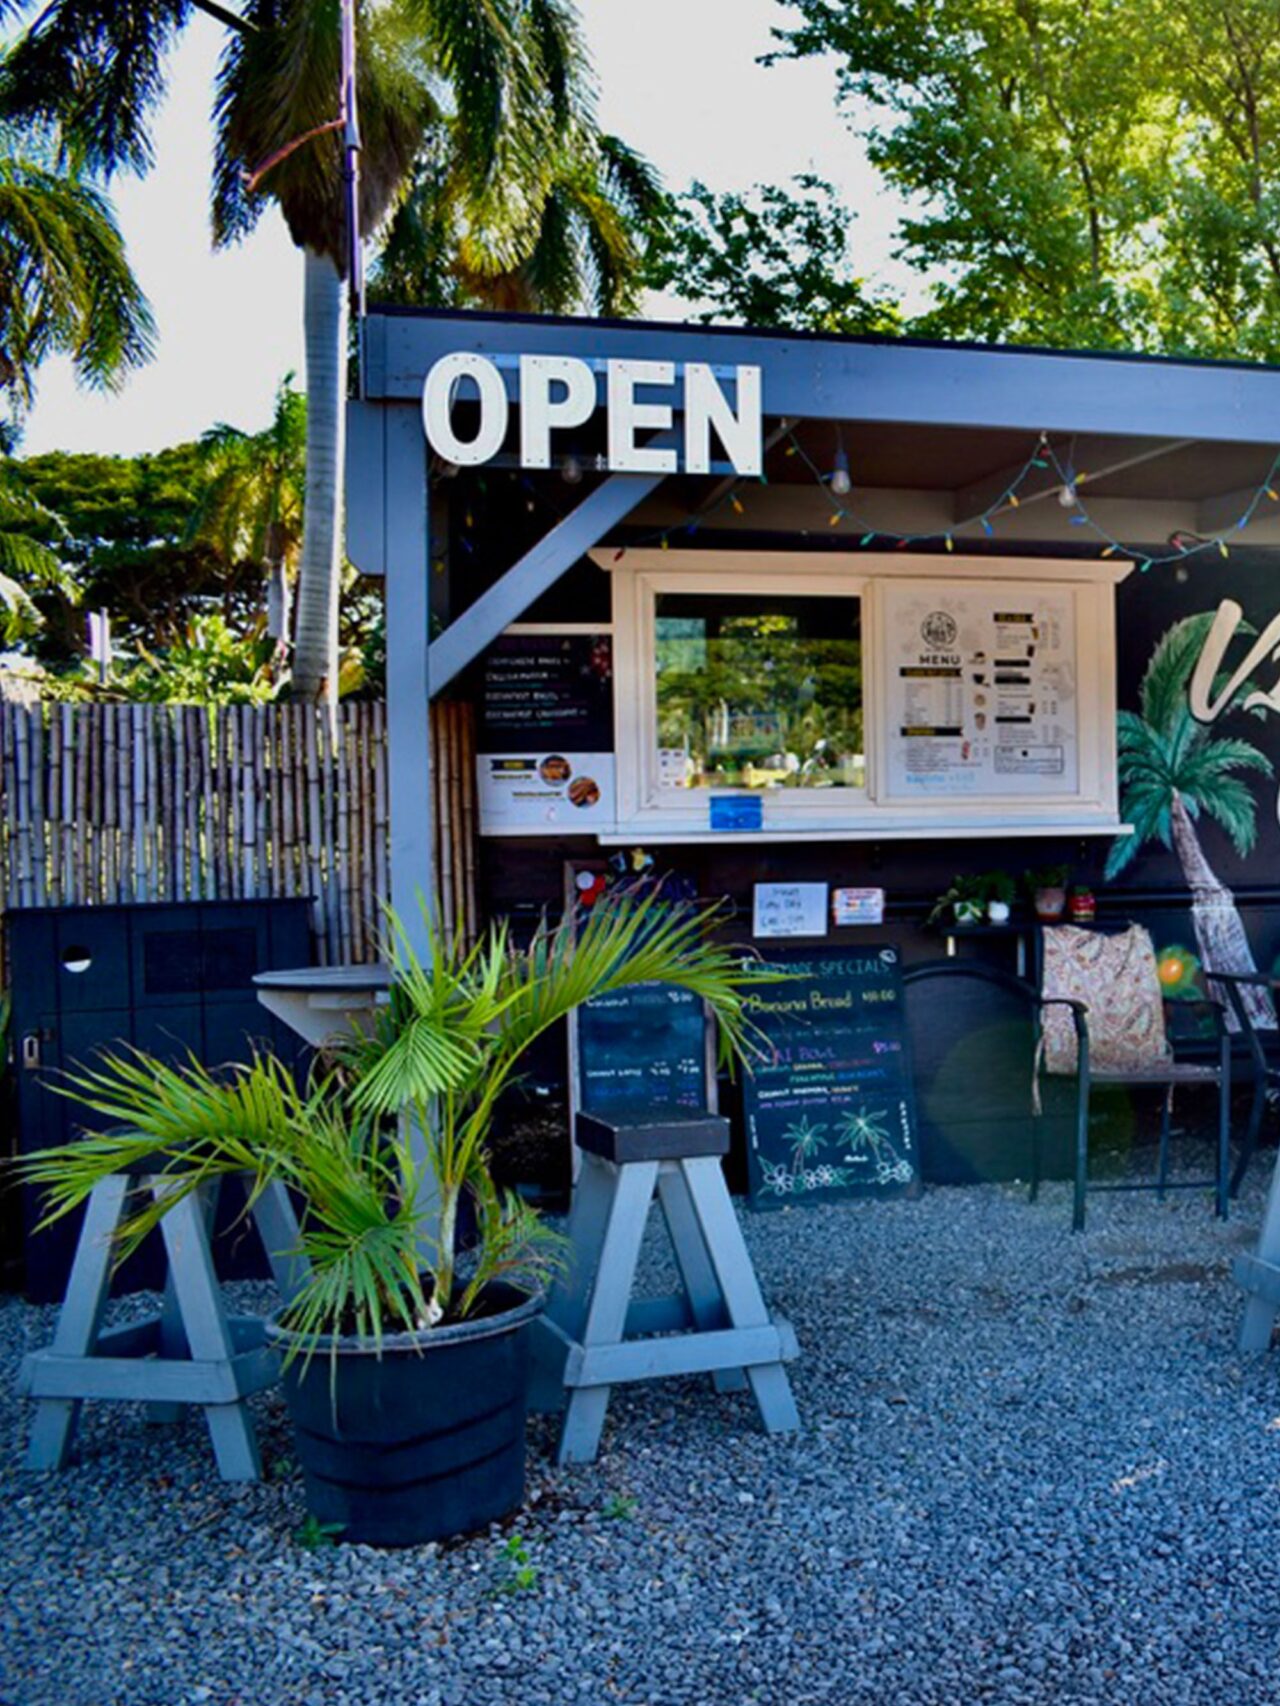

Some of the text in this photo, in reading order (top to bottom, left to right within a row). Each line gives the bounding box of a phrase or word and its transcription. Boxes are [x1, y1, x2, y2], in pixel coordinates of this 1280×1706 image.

[423, 351, 763, 477] OPEN
[919, 655, 961, 665] MENU
[819, 960, 891, 978] SPECIALS
[810, 989, 853, 1010] Bread
